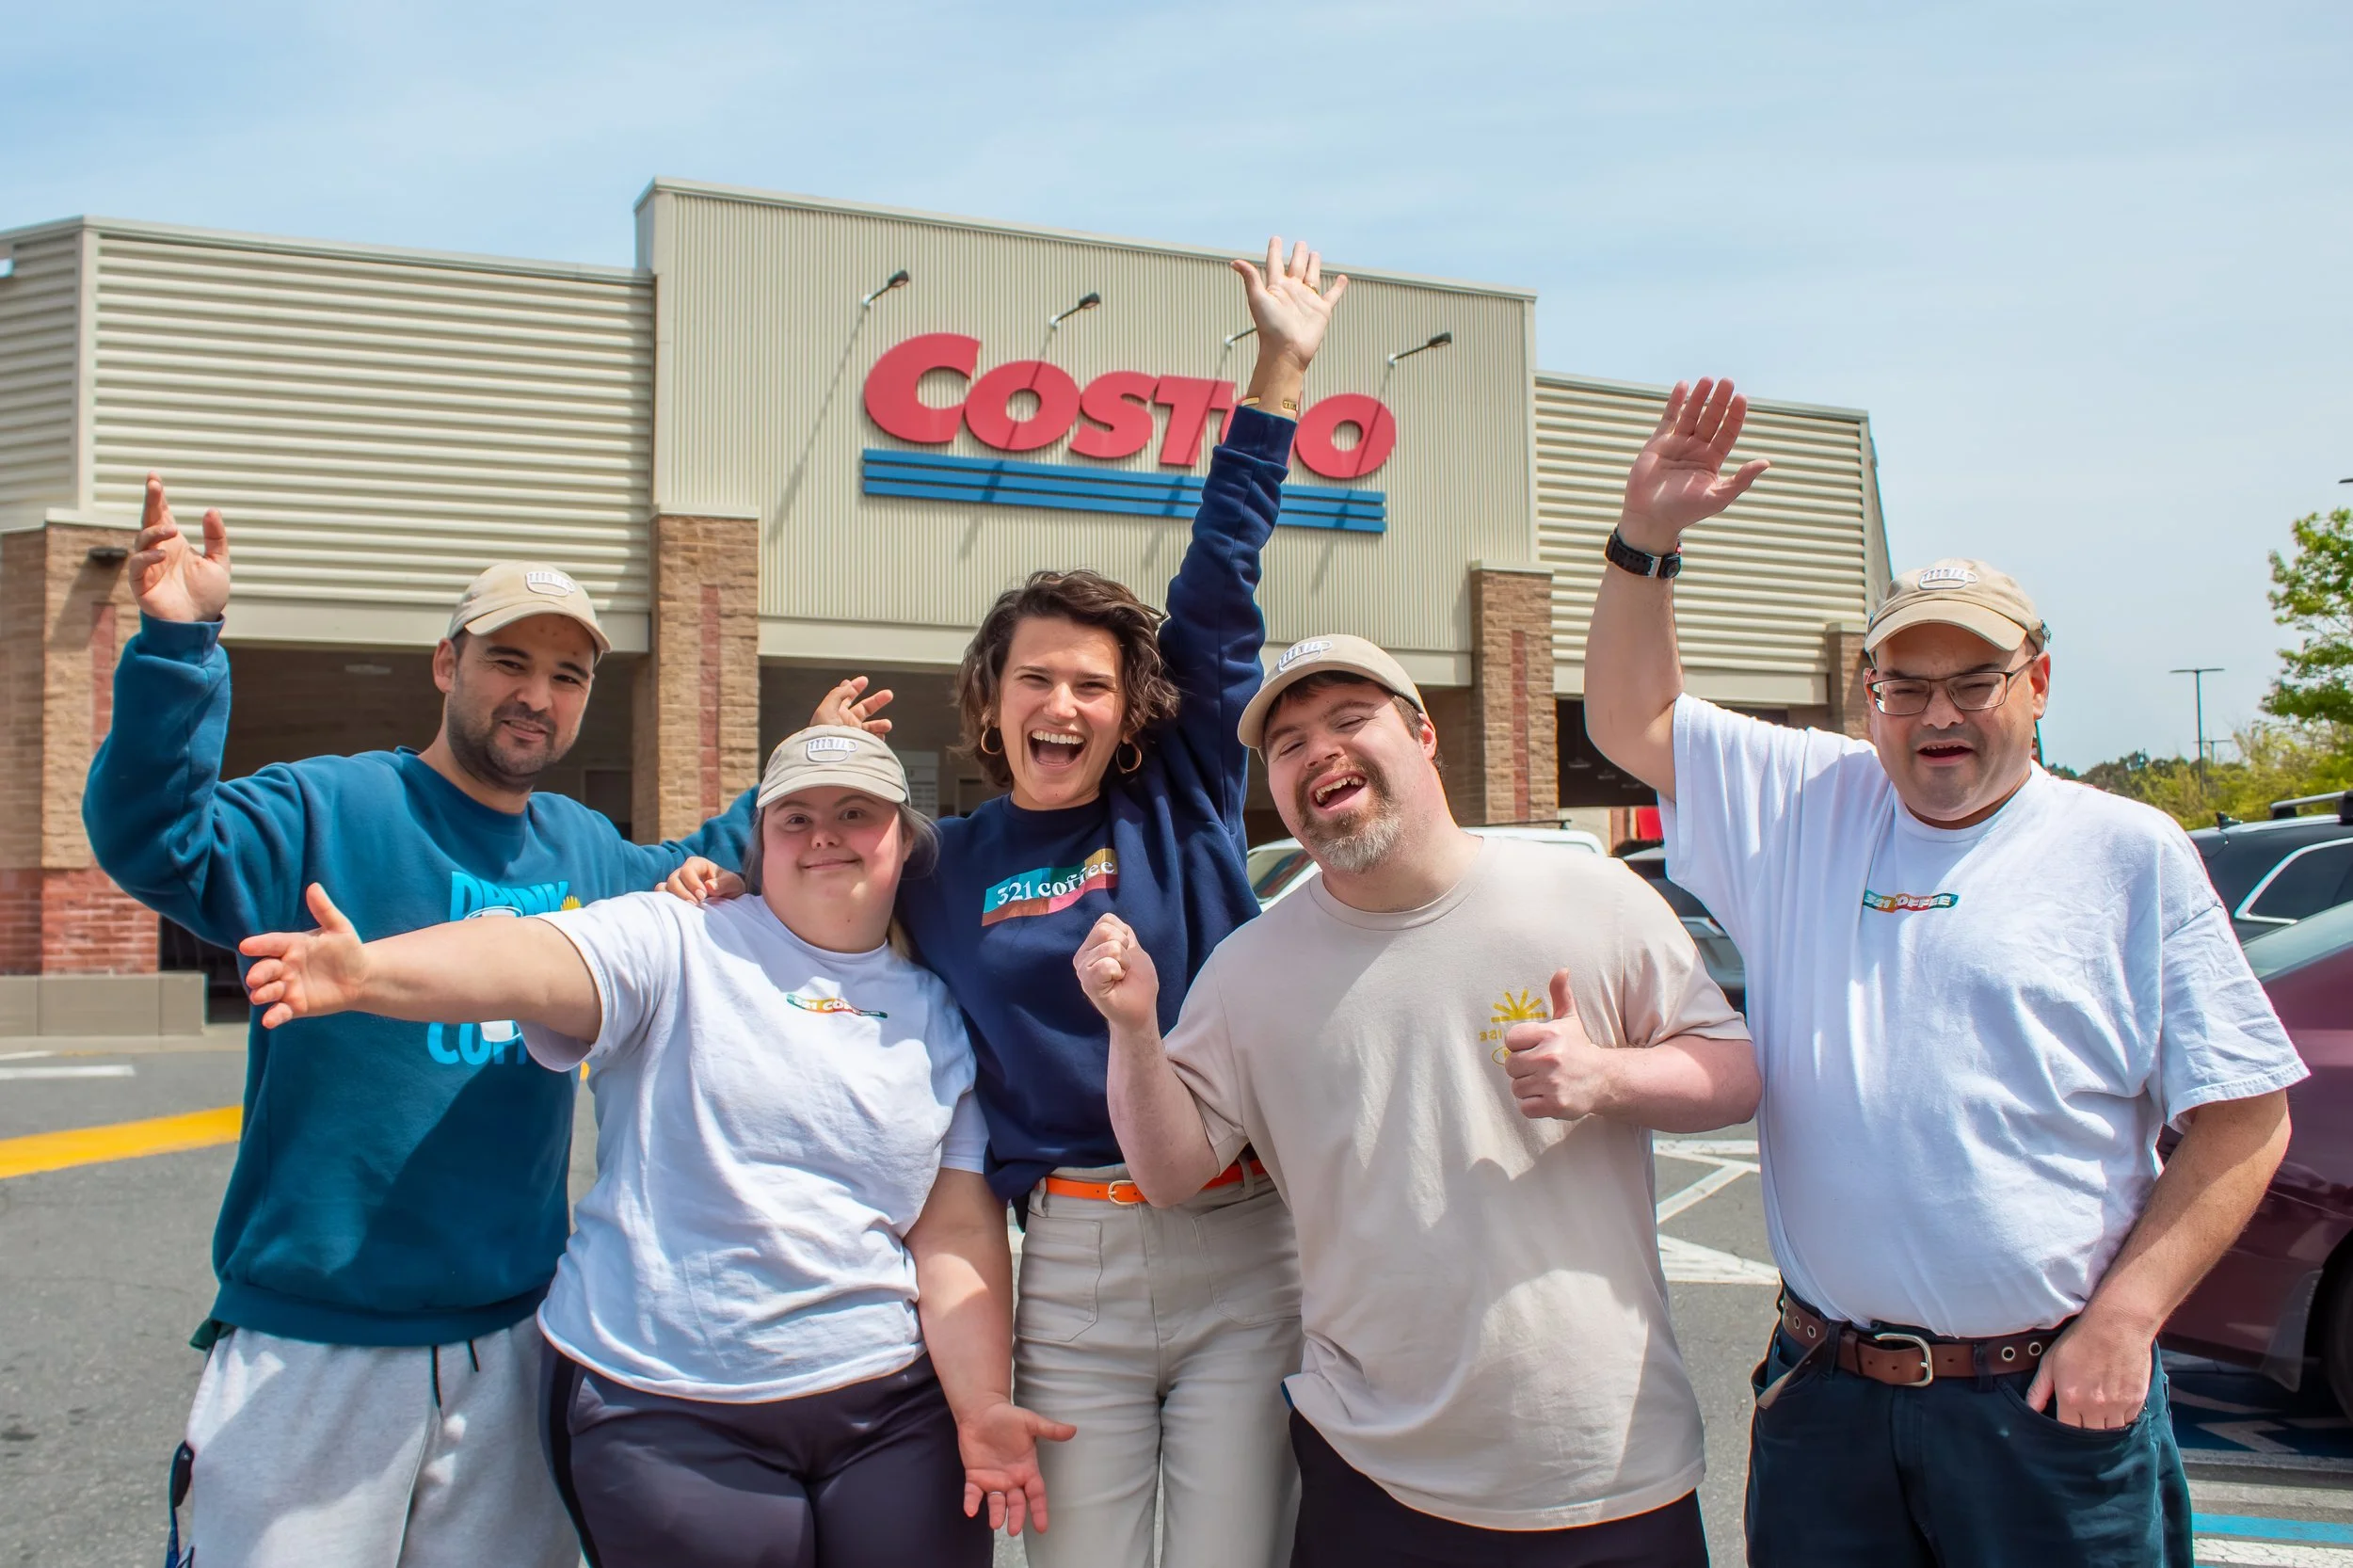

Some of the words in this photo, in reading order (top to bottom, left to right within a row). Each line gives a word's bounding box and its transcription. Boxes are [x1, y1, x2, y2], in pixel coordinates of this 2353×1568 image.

[863, 331, 1397, 480] COSTO
[997, 880, 1033, 906] 321
[1037, 861, 1114, 898] coffee
[1895, 895, 1951, 908] OFFEE
